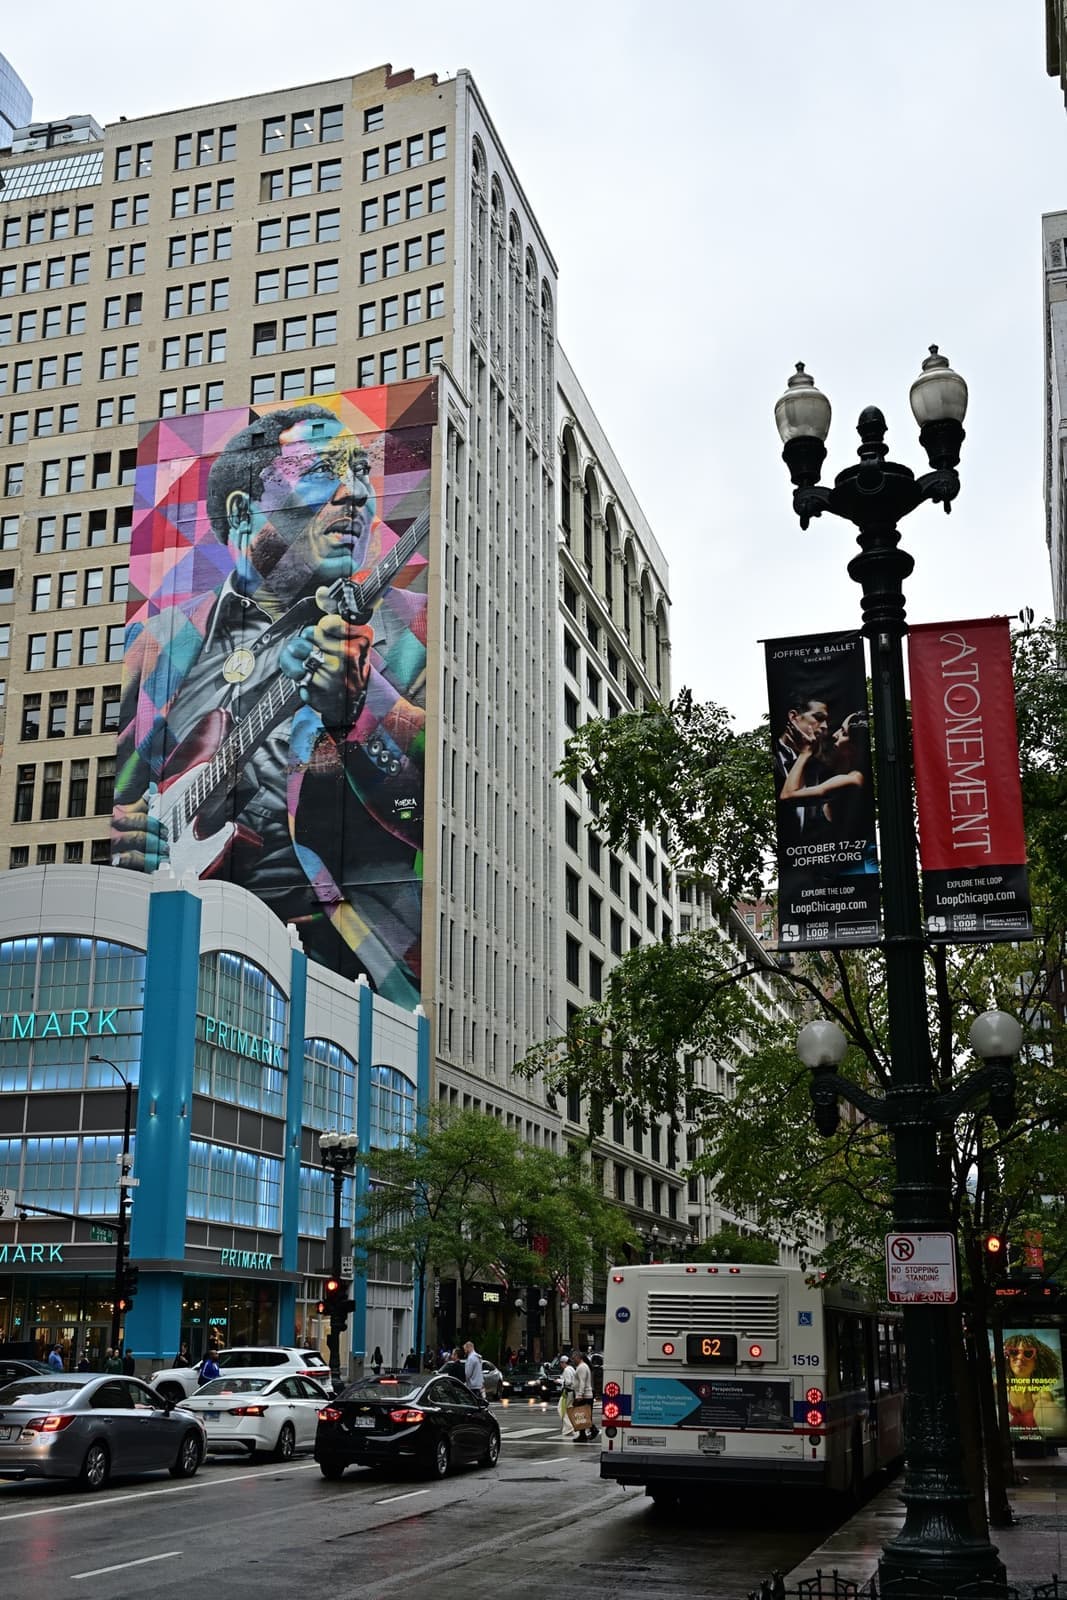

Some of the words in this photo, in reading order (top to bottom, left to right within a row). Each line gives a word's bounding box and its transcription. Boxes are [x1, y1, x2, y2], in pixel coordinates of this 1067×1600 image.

[771, 648, 811, 660] JOFFREY
[823, 642, 858, 654] BALLET
[940, 632, 991, 855] ATONEMENT
[786, 843, 836, 856] OCTOBER
[792, 851, 863, 868] JOFFREY.ORG
[946, 879, 974, 889] EXPLORE
[975, 878, 986, 886] THE
[987, 876, 1003, 885] LOOP
[801, 888, 827, 898] EXPLORE
[828, 887, 838, 896] THE
[839, 886, 856, 895] LOOP
[936, 890, 1016, 907] LoopChicago.com
[791, 900, 868, 915] LoopChicago.com
[954, 920, 977, 928] LOOP
[806, 929, 829, 937] LOOP
[0, 1007, 119, 1040] MARK
[205, 1015, 284, 1070] PRIMARK
[221, 1248, 273, 1271] PRIMARK
[891, 1266, 902, 1274] NO
[905, 1266, 939, 1274] STOPPING
[919, 1292, 951, 1302] ZONE
[701, 1339, 721, 1356] 62
[792, 1354, 820, 1367] 1519
[1011, 1385, 1026, 1393] stay
